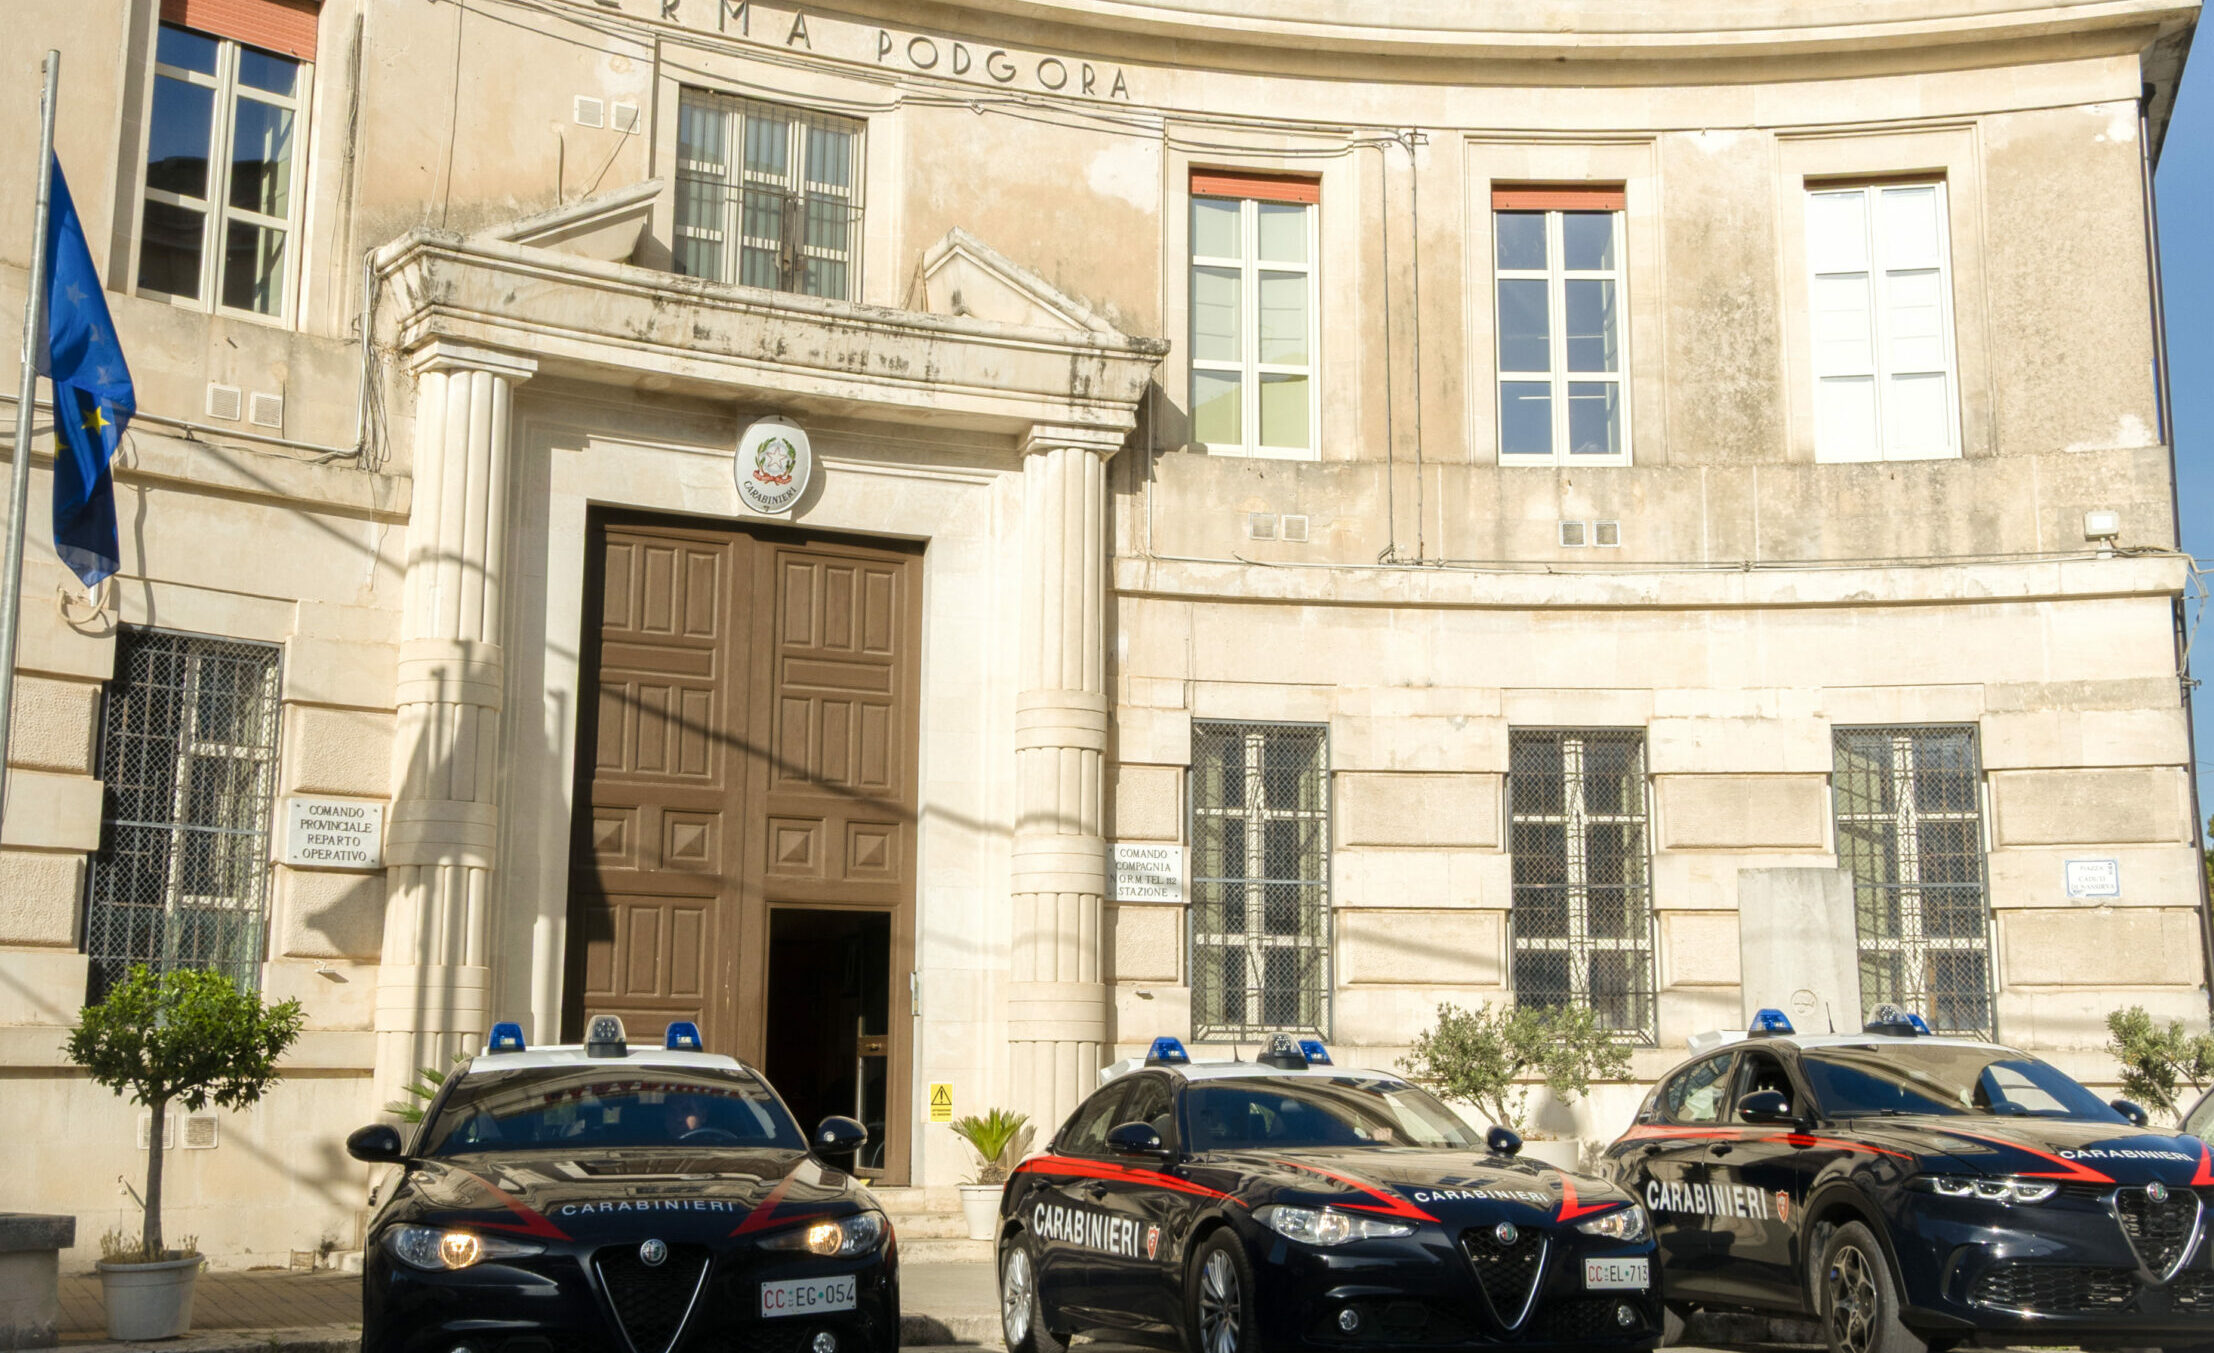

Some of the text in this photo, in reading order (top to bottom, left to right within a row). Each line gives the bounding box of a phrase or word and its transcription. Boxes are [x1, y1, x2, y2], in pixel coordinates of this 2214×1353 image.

[593, 0, 1130, 100] RMA PODGORA
[743, 480, 797, 504] CARABINIERI
[309, 805, 365, 818] COMANDO
[300, 819, 372, 834] PROVINCIALE
[307, 834, 361, 847] REPARTO
[302, 848, 367, 862] OPERATIVO
[1120, 848, 1168, 859] COMANDO
[1115, 861, 1171, 872] COMPAGNIA
[1119, 887, 1168, 897] STAZIONE
[2060, 1149, 2196, 1162] CARABINIERI
[1414, 1190, 1549, 1202] CARABINIERI
[1646, 1180, 1768, 1220] CARABINIERI
[561, 1200, 734, 1216] CARABINIERI
[1034, 1202, 1140, 1258] CARABINIERI
[1588, 1264, 1648, 1282] CC EL 713
[764, 1283, 854, 1309] CC EG 054
